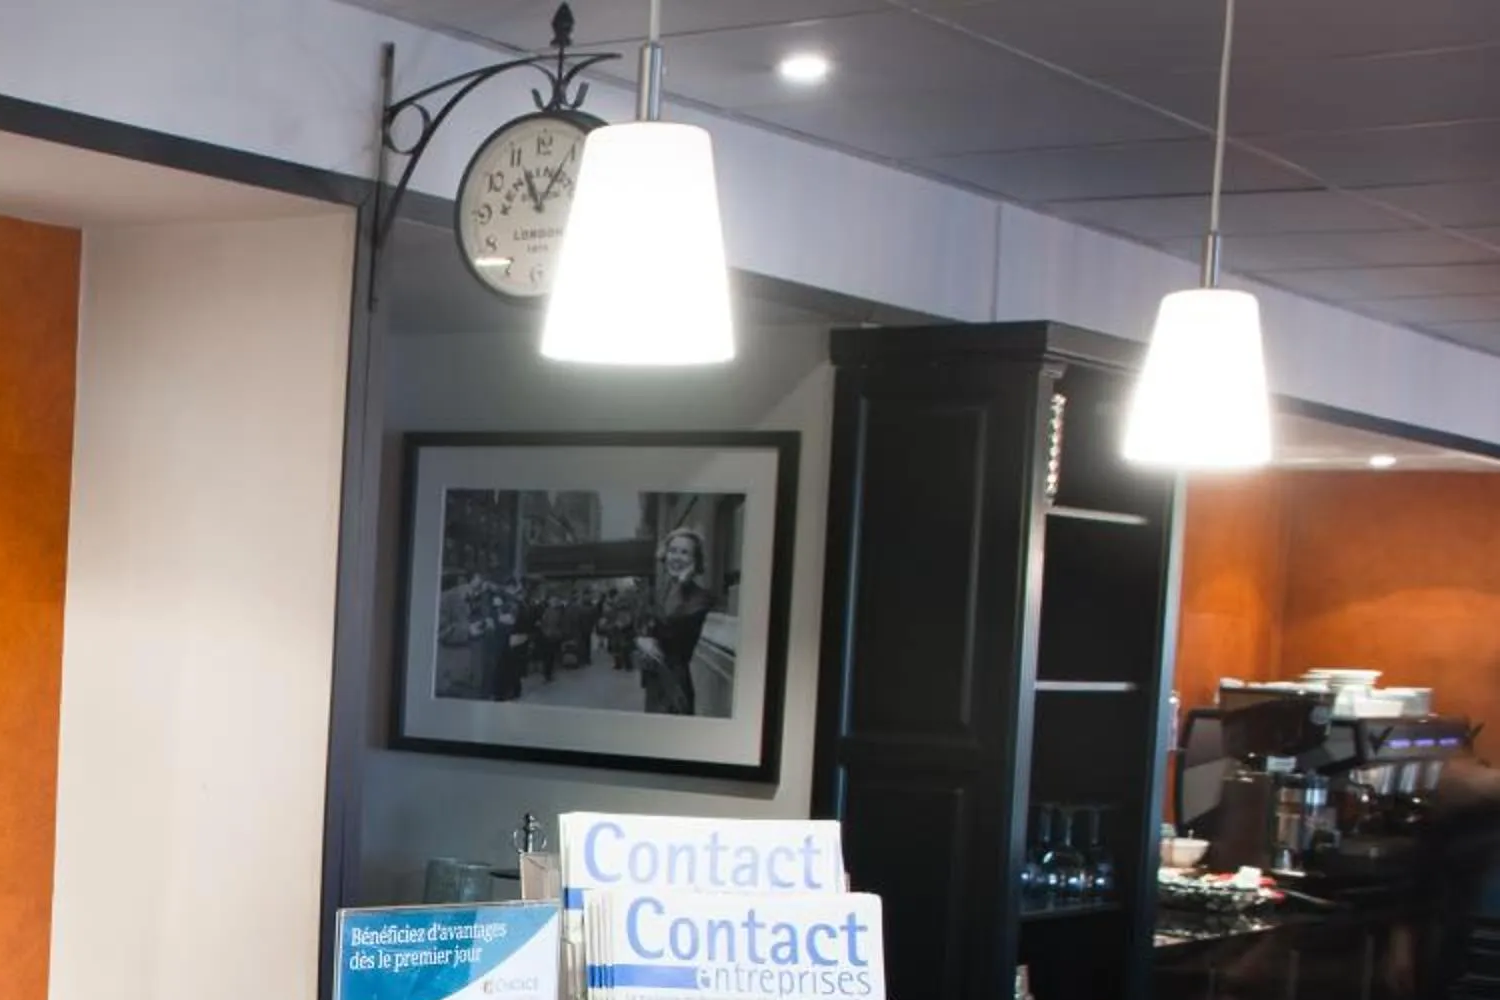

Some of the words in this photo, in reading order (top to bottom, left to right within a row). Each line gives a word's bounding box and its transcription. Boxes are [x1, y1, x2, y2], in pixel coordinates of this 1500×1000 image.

[583, 821, 823, 889] Contact
[351, 924, 425, 946] Bénéficiez
[427, 922, 508, 943] d'avantages
[626, 896, 869, 967] Contact
[350, 952, 375, 970] dès
[378, 949, 392, 968] le
[394, 951, 450, 973] premier
[452, 947, 483, 969] jour
